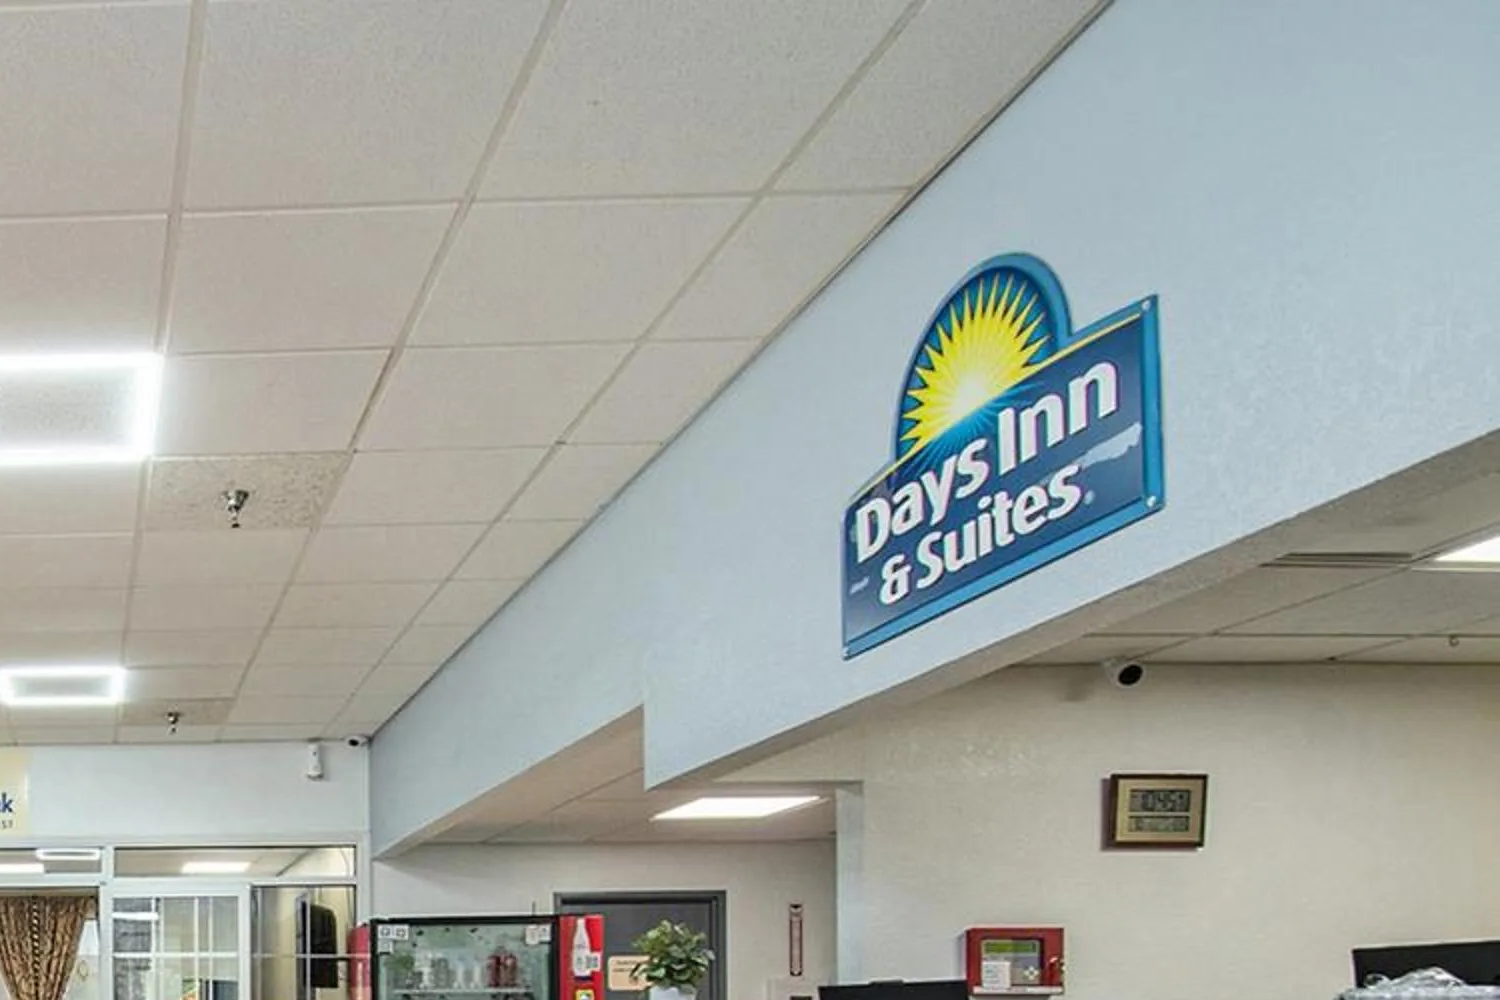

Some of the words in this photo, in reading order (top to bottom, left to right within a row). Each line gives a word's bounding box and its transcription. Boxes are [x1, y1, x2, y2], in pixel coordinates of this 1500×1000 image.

[854, 438, 990, 564] Days
[997, 362, 1118, 476] Inn
[879, 554, 912, 605] &
[916, 464, 1082, 590] Suites
